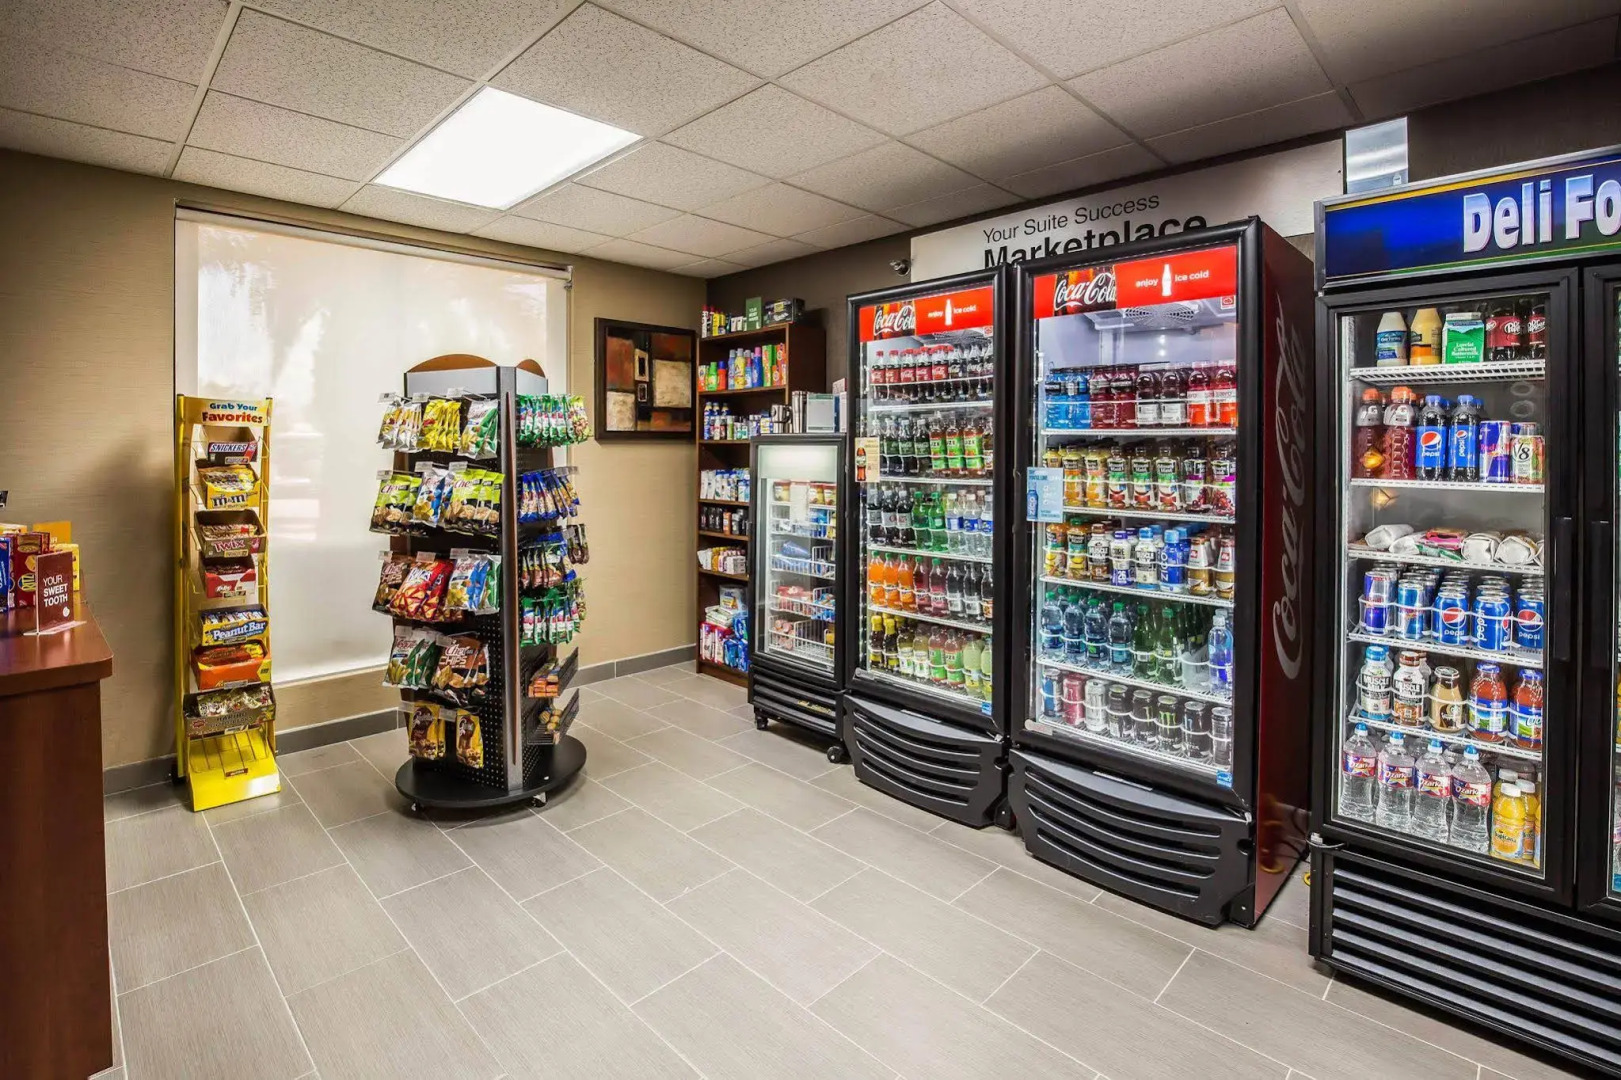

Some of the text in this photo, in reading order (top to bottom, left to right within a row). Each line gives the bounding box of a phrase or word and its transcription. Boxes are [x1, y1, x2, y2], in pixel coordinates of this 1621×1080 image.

[983, 195, 1160, 243] Your Suite Success
[1463, 179, 1552, 253] Deli
[1135, 278, 1158, 288] enjoy
[1189, 270, 1210, 280] cold
[1054, 272, 1116, 311] Coca-Cola
[874, 305, 915, 336] Coca-Cola
[237, 403, 258, 412] Your
[202, 412, 263, 424] Favorites
[210, 444, 247, 452] SNICKERS
[1513, 442, 1530, 460] V8
[1272, 292, 1307, 680] Coca-Cola
[213, 539, 245, 553] Twix
[43, 574, 63, 587] YOUR
[43, 583, 68, 597] SWEET
[44, 593, 68, 607] TOOTH
[213, 625, 250, 640] Peanut
[249, 621, 266, 631] Bar
[1444, 629, 1464, 638] pepsi
[1518, 632, 1540, 640] pepsi
